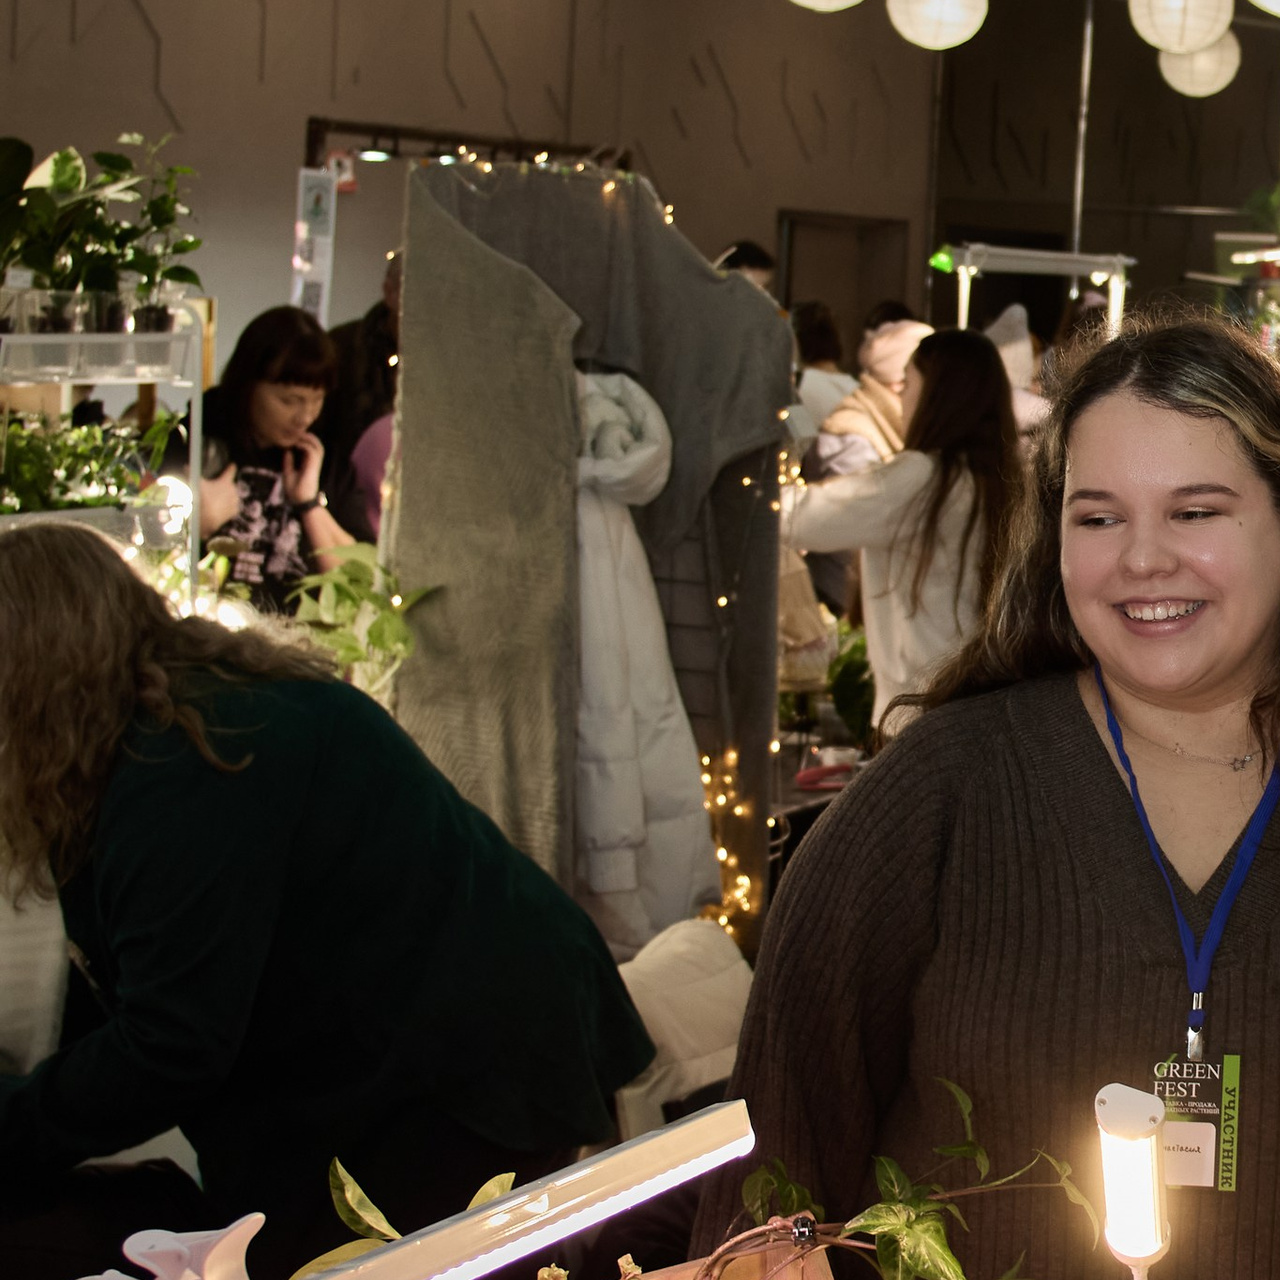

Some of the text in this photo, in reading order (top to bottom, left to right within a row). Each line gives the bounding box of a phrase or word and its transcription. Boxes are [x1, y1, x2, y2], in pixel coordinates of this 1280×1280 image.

[1153, 1061, 1222, 1080] GREEN
[1153, 1081, 1200, 1098] FEST
[1221, 1086, 1236, 1188] УЧАСТНИК
